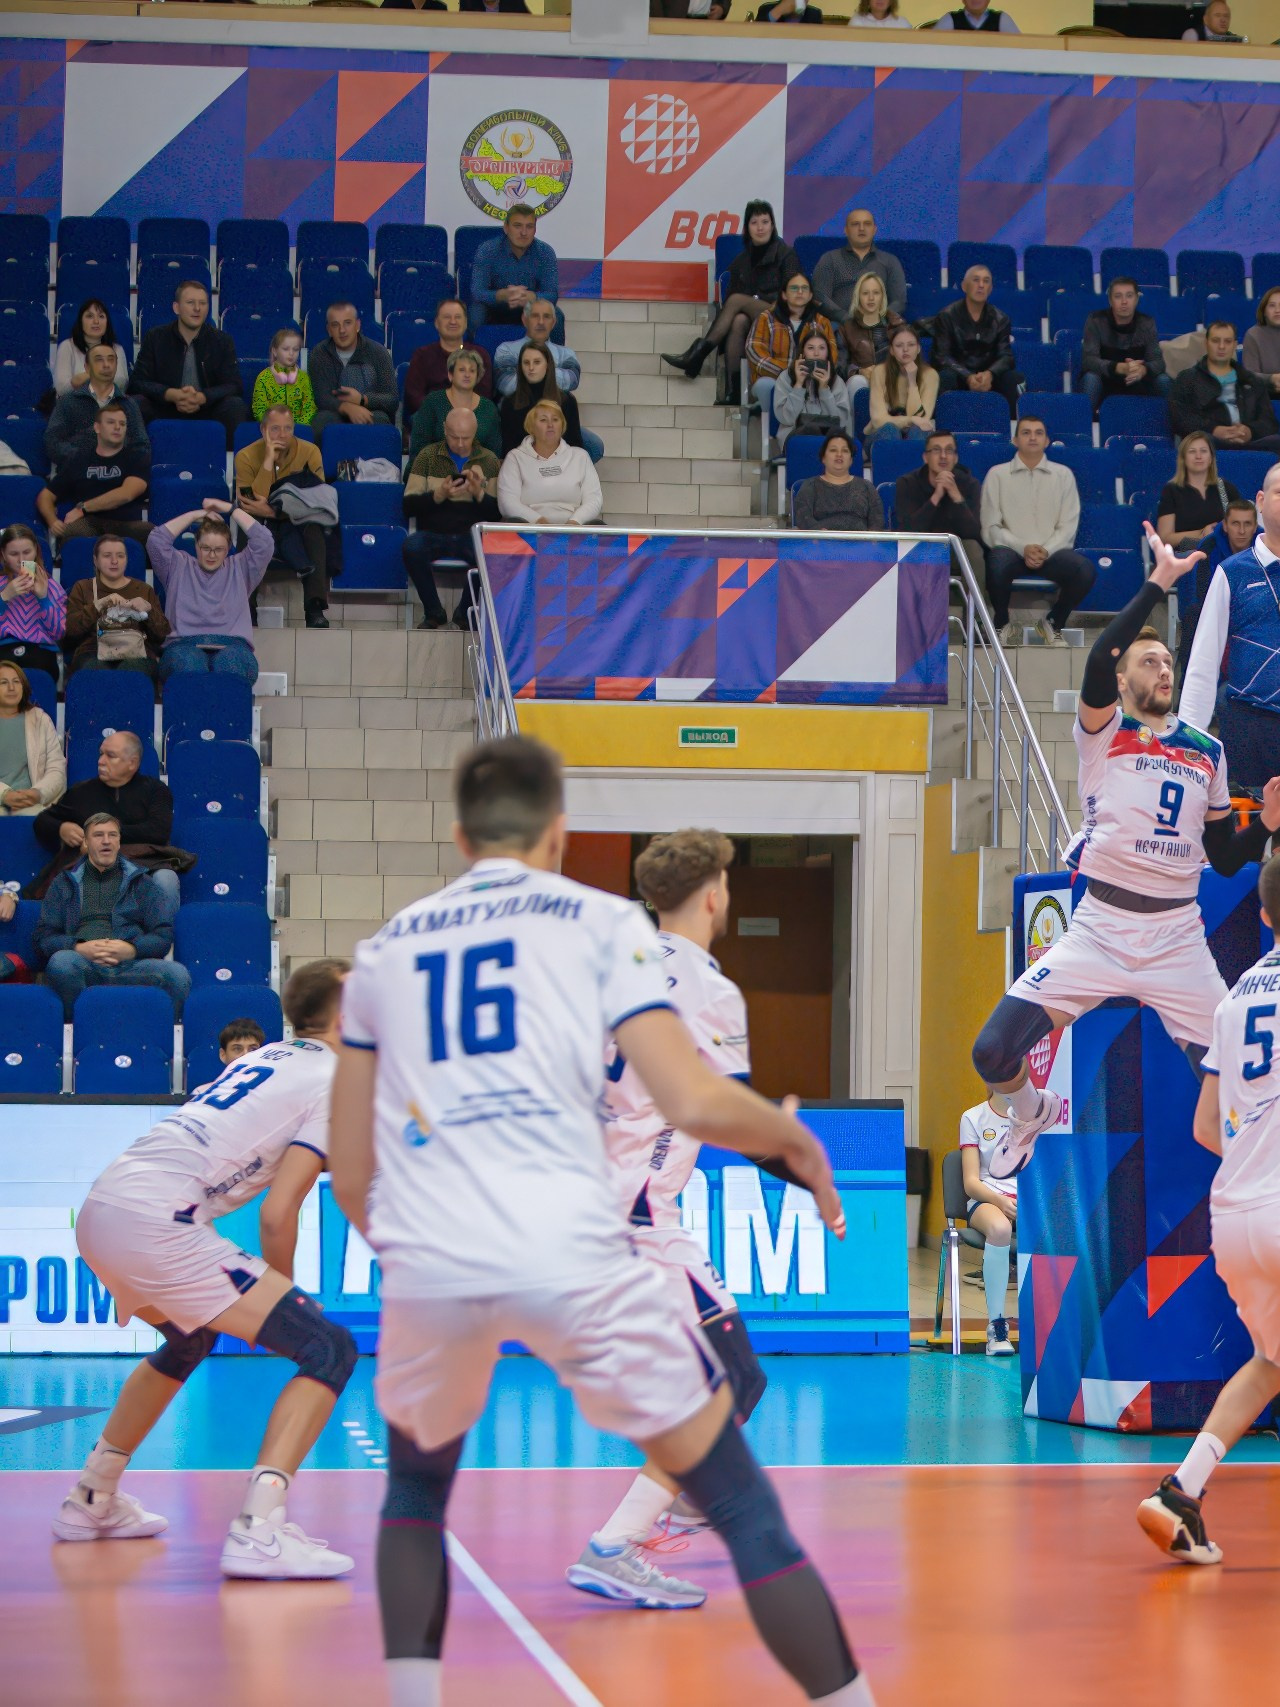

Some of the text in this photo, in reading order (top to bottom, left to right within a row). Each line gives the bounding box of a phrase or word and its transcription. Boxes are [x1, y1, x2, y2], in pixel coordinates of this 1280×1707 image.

[465, 111, 569, 152] ВОЛЕЙБОЛЬНЫЙ КЛУБ
[664, 210, 741, 250] ВФ
[86, 465, 122, 480] FILA
[687, 731, 729, 743] ВЫХОД
[1156, 779, 1185, 828] 9
[1135, 839, 1192, 858] НЕФТЯНИК
[376, 892, 583, 946] АХМАТУЛЛИН
[1031, 967, 1051, 983] 9
[414, 936, 518, 1063] 16
[1242, 1003, 1278, 1081] 5
[189, 1063, 275, 1111] 13
